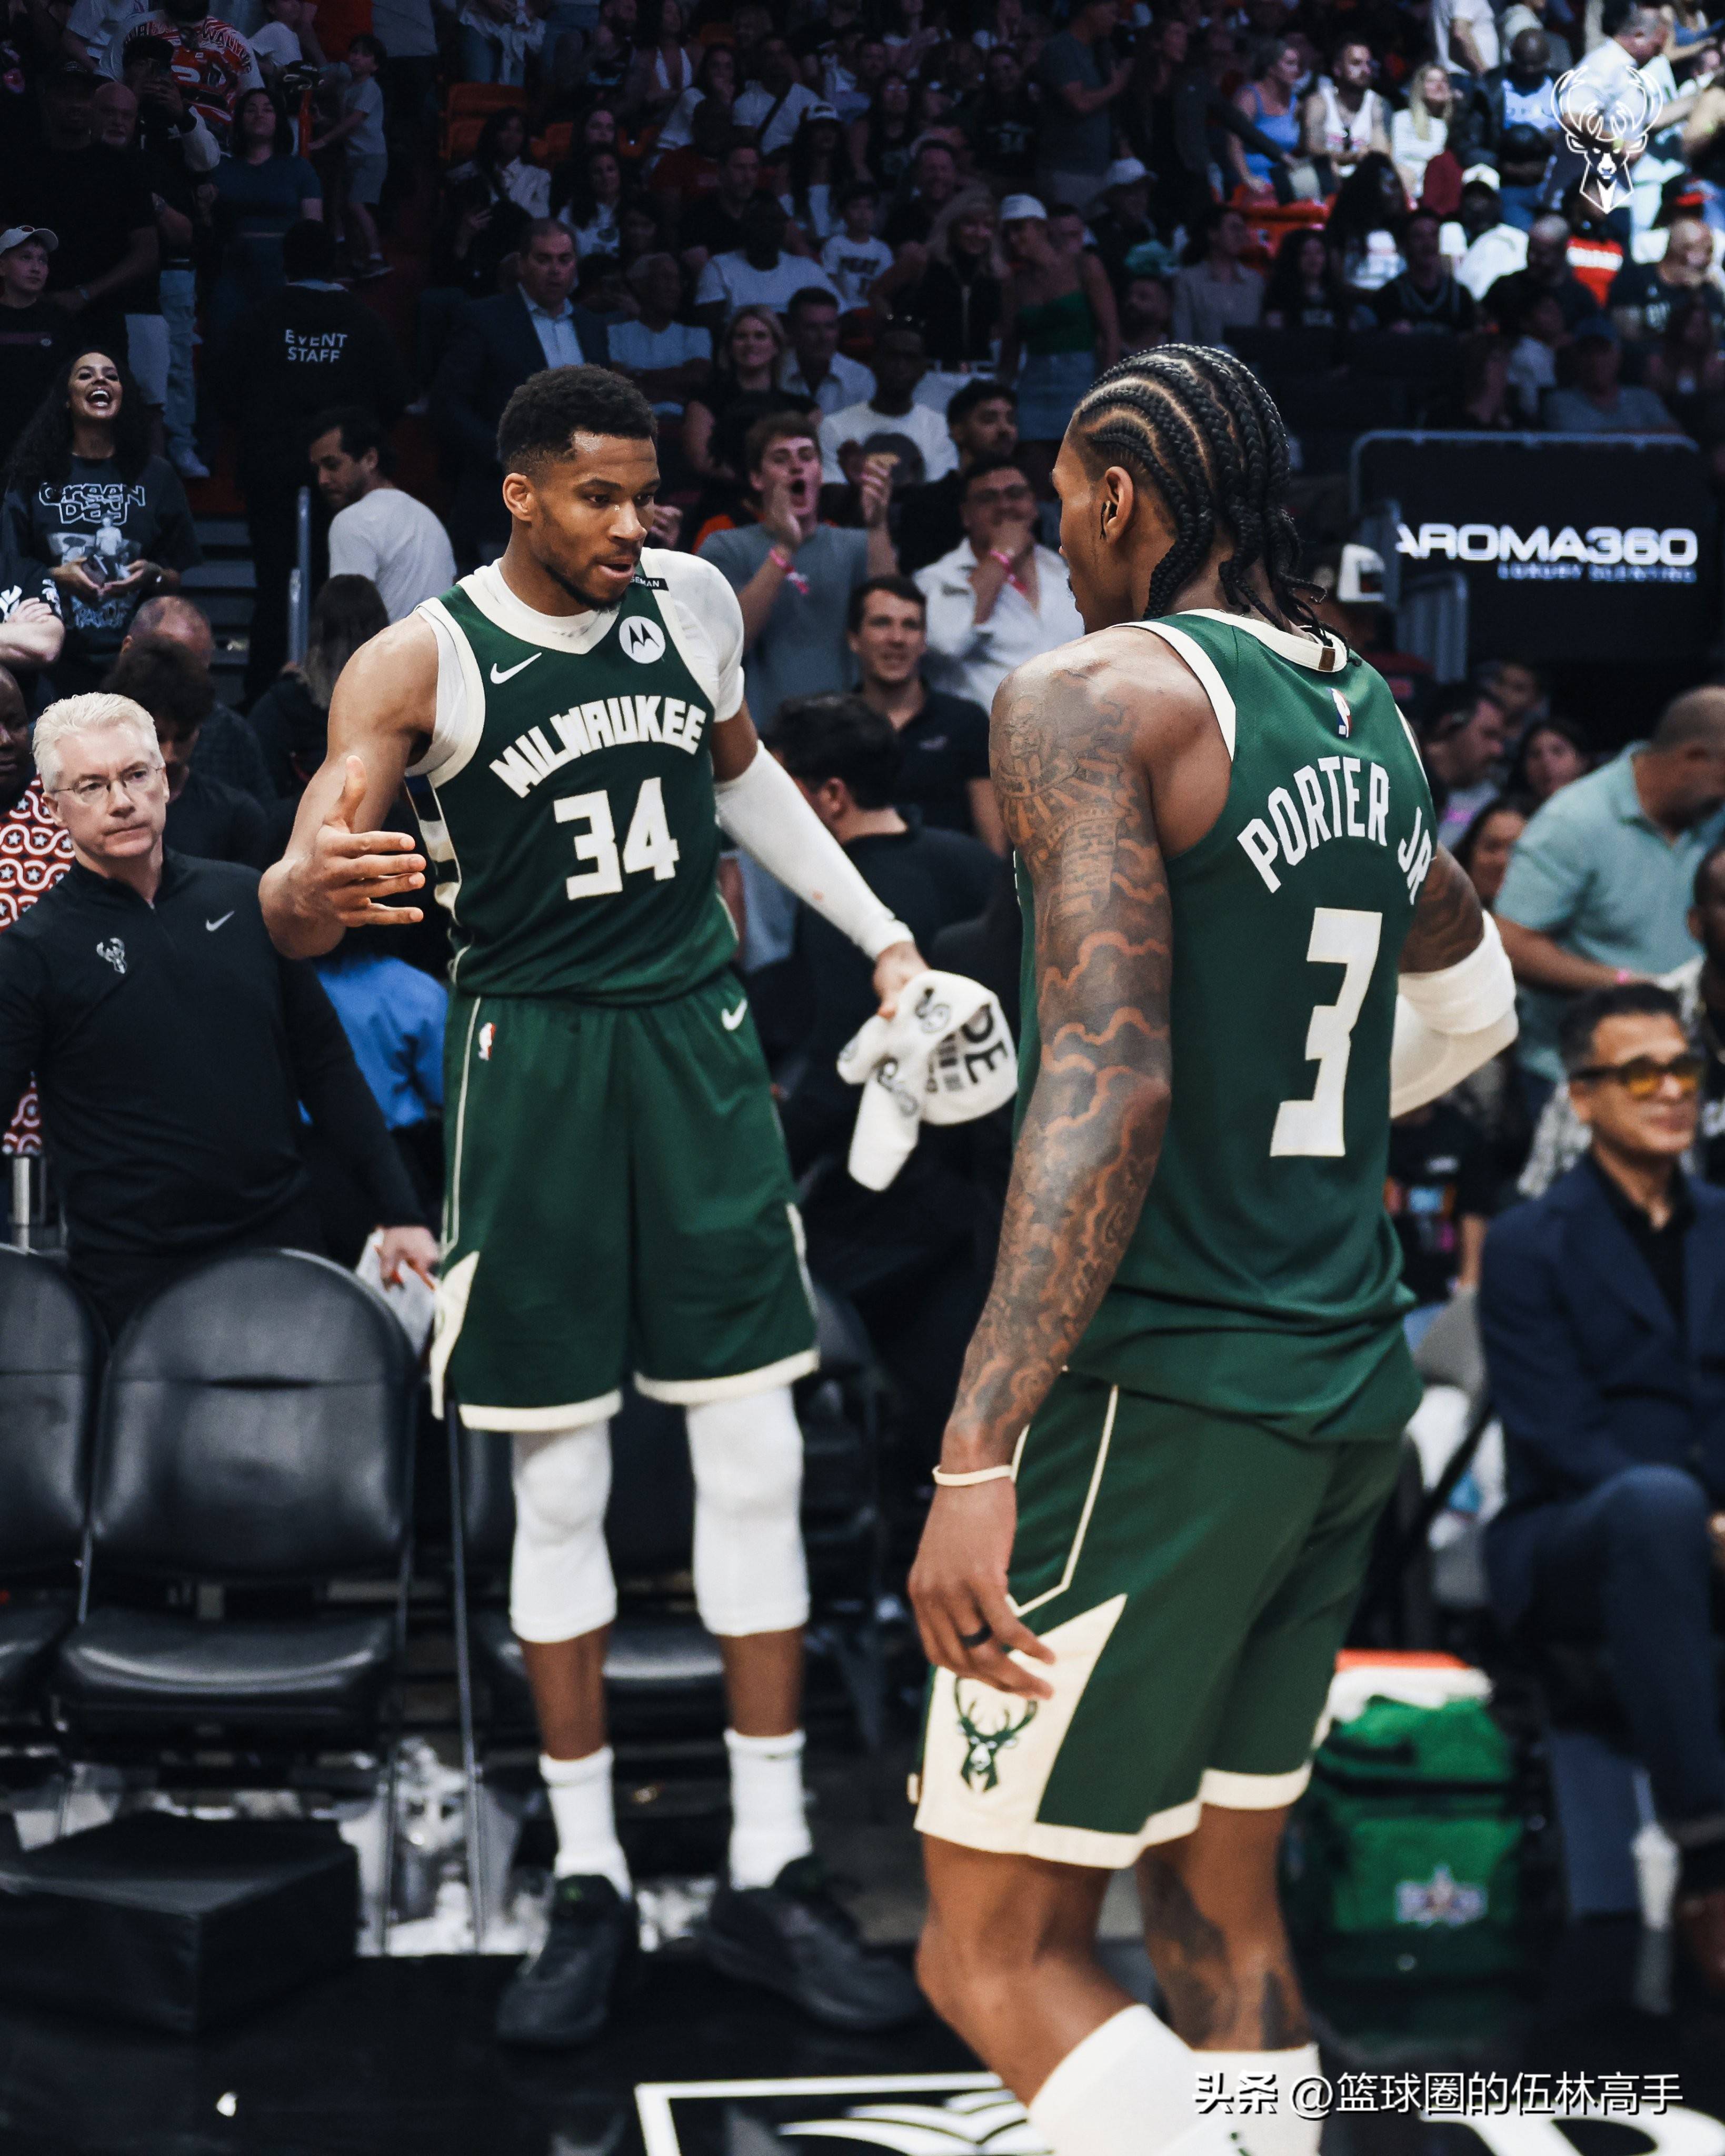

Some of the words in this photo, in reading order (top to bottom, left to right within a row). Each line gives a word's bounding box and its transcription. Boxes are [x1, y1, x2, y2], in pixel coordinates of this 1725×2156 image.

[285, 328, 350, 348] EVENT
[286, 346, 342, 363] STAFF
[488, 695, 707, 798] MILWAUKEE
[553, 776, 680, 901] 34
[1237, 755, 1391, 894] PORTER
[1269, 907, 1383, 1157] 3
